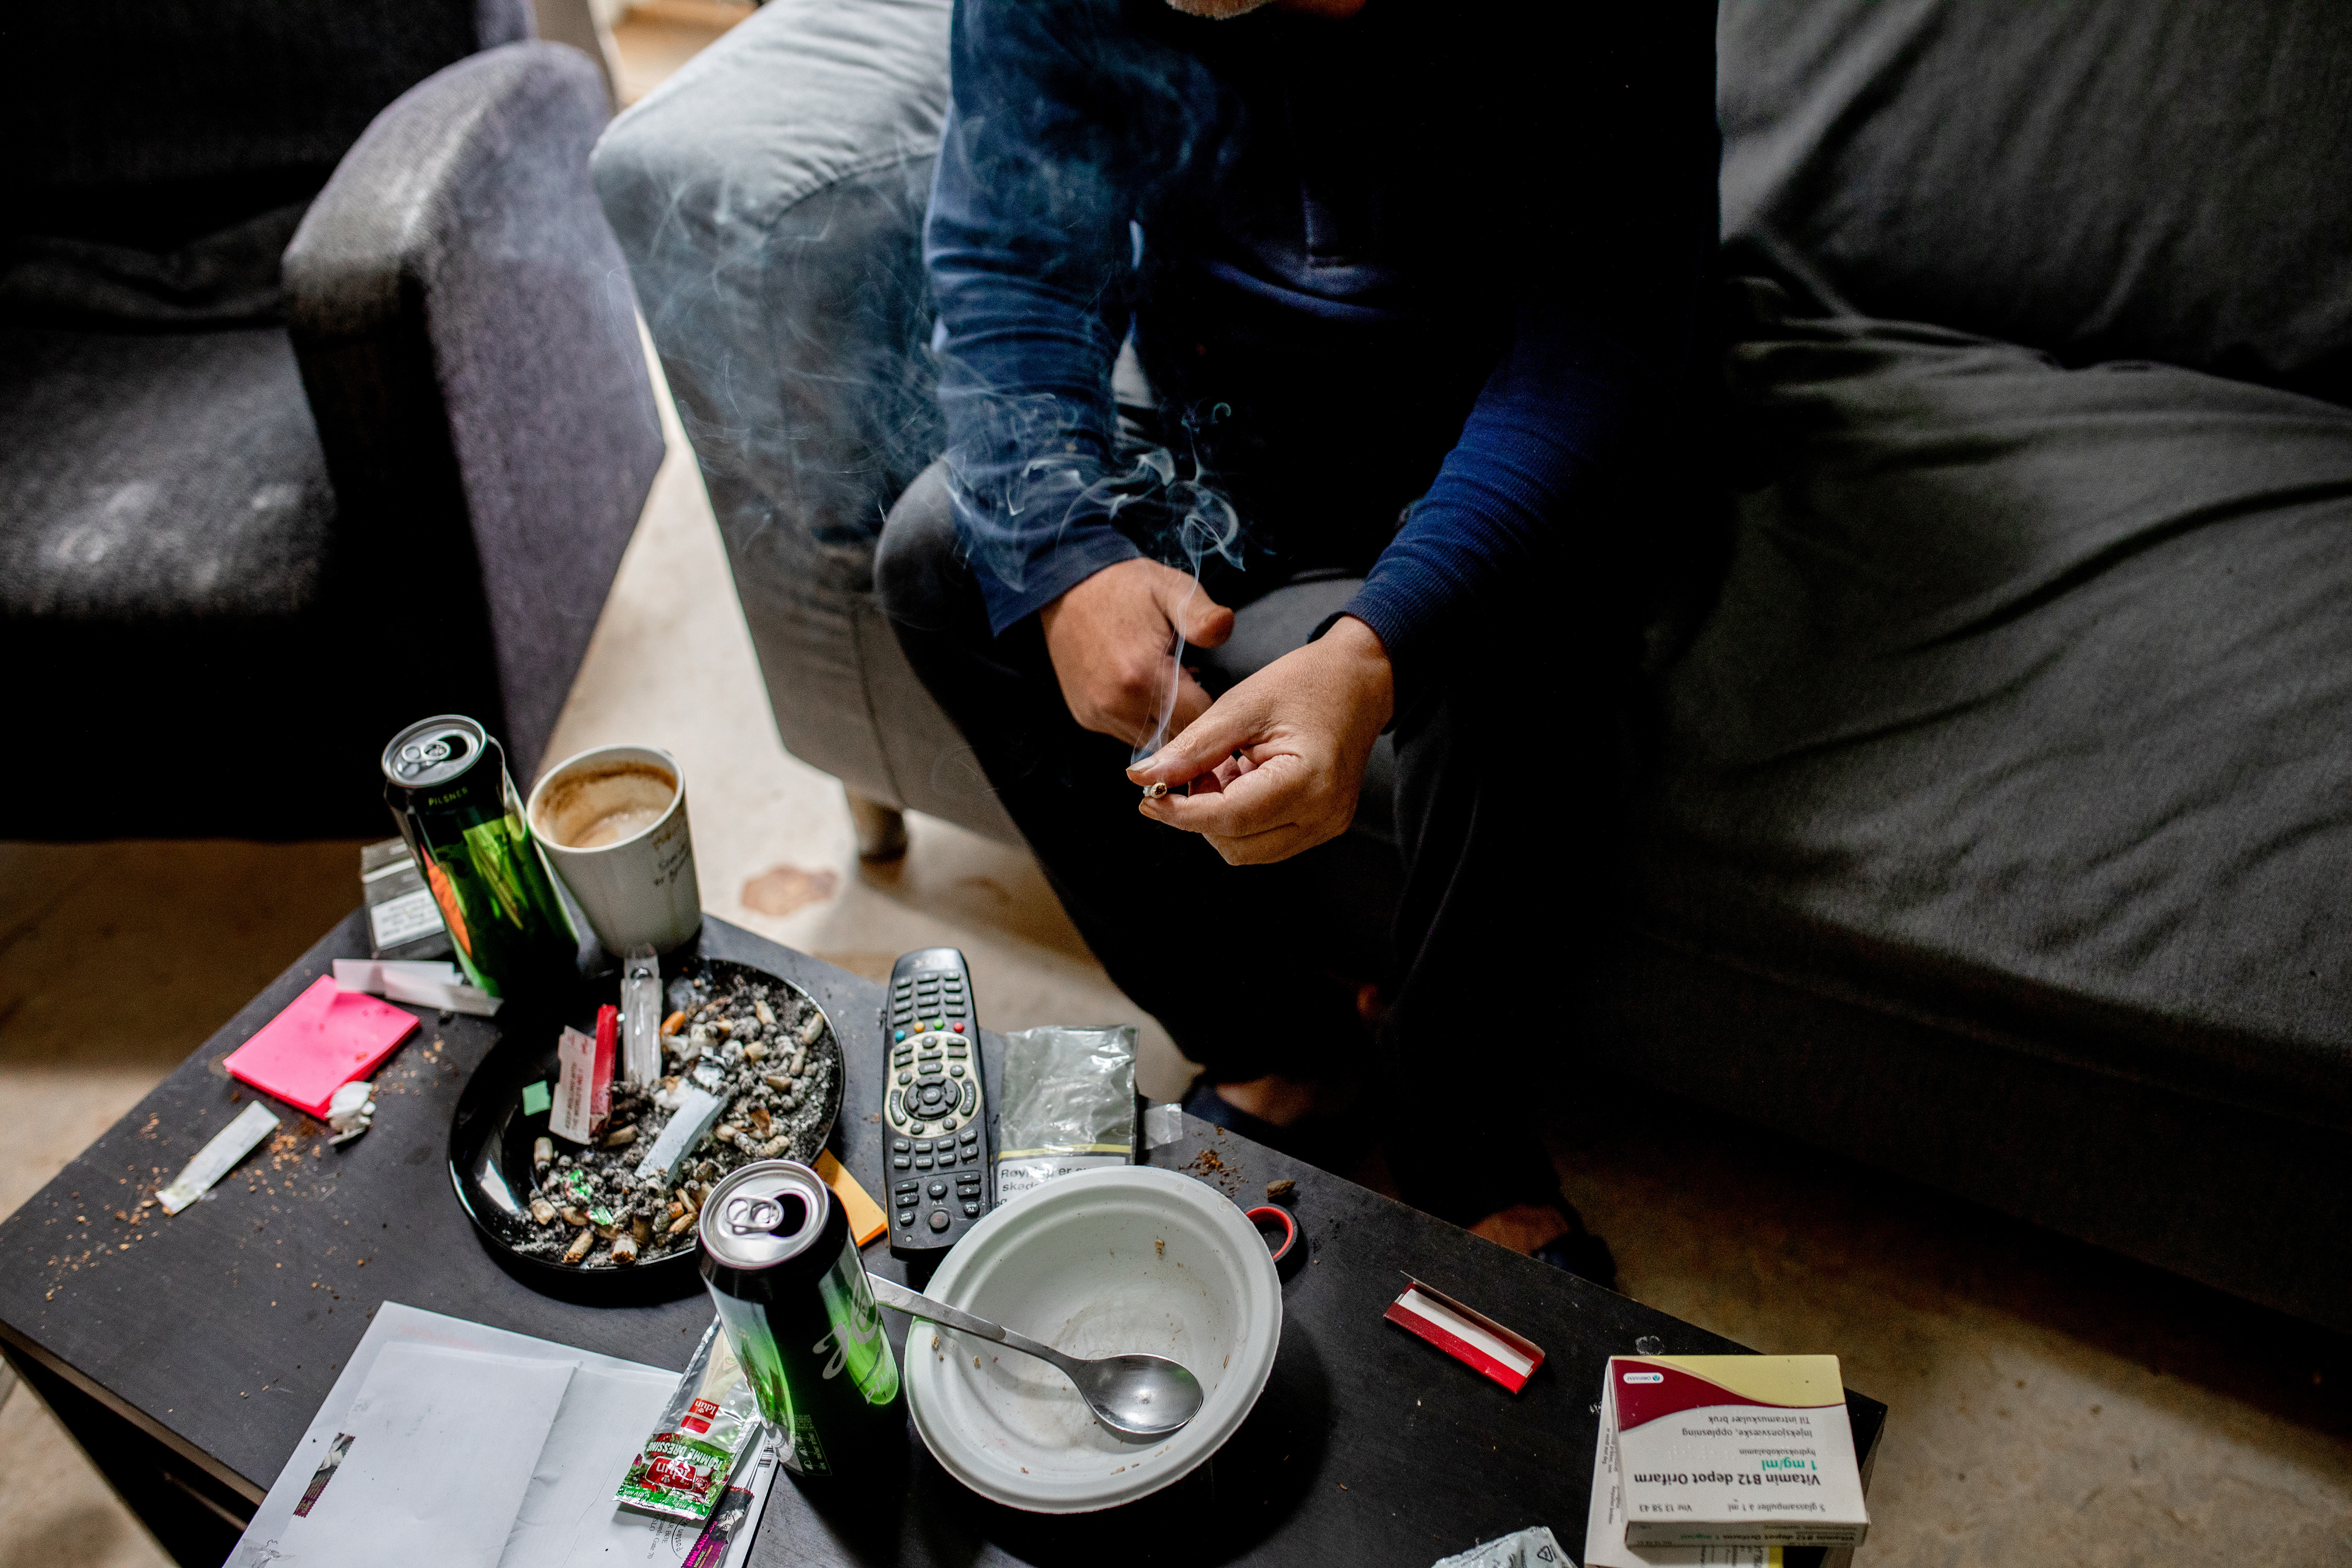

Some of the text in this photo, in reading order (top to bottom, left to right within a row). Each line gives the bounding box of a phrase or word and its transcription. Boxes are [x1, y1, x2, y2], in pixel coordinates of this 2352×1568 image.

[429, 787, 468, 806] PILSNER
[1059, 1167, 1071, 1175] er
[694, 1400, 718, 1415] Idun
[1708, 1416, 1810, 1425] Til intramuskulær bruk
[1682, 1427, 1812, 1437] Injeksjonsvæske, oppløsning
[646, 1441, 688, 1456] DRESSING
[1762, 1456, 1817, 1471] 1 mg/ml
[1634, 1471, 1821, 1485] Vitamin B12 depot Orifarm
[1639, 1504, 1692, 1512] Vnr 13 58 43
[1727, 1503, 1738, 1512] ml
[1758, 1503, 1818, 1512] glassampuller
[649, 1514, 660, 1531] OSLO
[650, 1537, 660, 1551] Gate
[675, 1528, 684, 1552] Posten
[686, 1534, 709, 1567] INNLAND
[694, 1550, 706, 1567] NORGE
